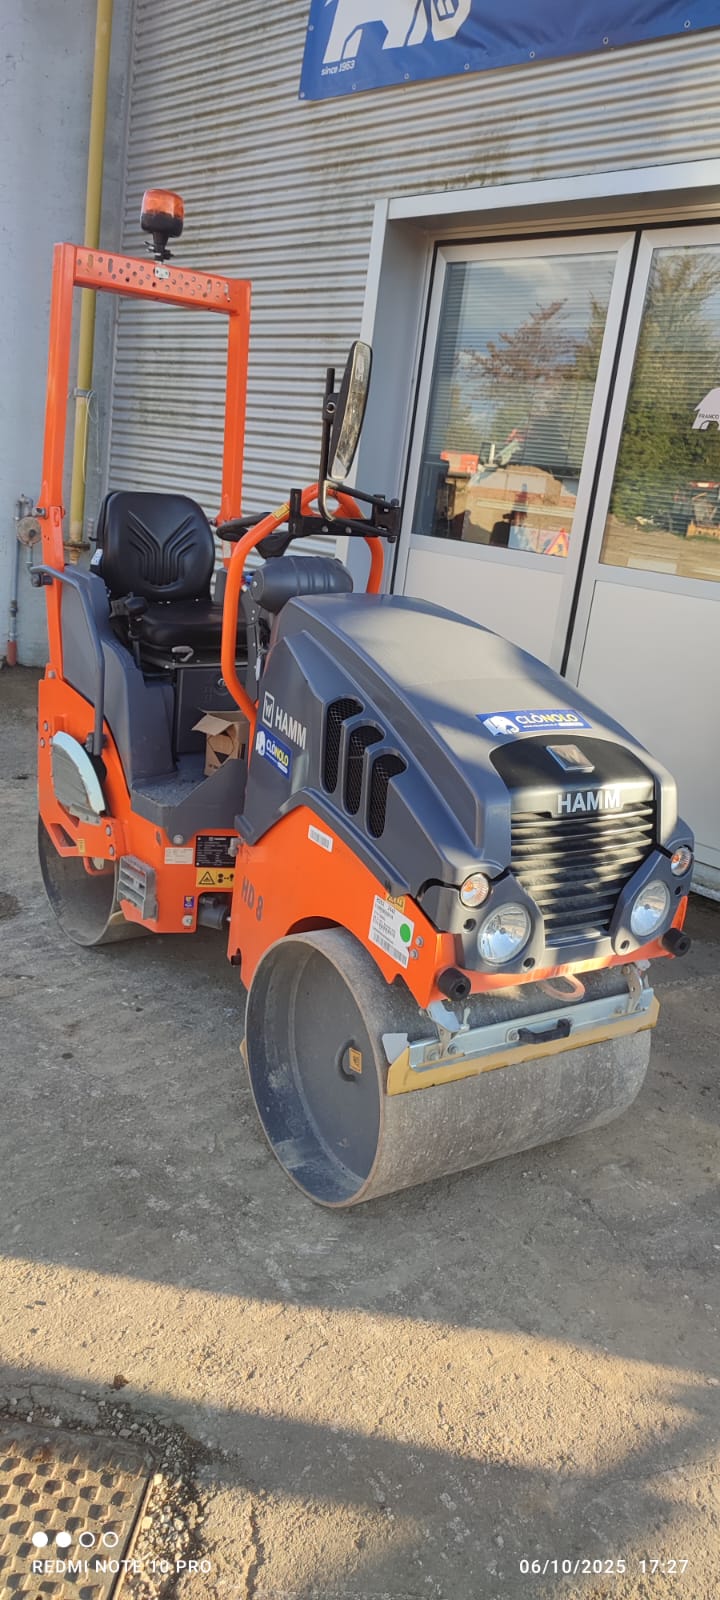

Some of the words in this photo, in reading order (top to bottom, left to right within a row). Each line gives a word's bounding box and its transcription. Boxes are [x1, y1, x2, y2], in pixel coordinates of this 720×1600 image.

[321, 65, 338, 76] since
[339, 60, 356, 72] 1963
[275, 705, 307, 751] HAMM
[557, 788, 622, 814] HAMM
[242, 874, 255, 911] HD
[256, 895, 264, 922] 8
